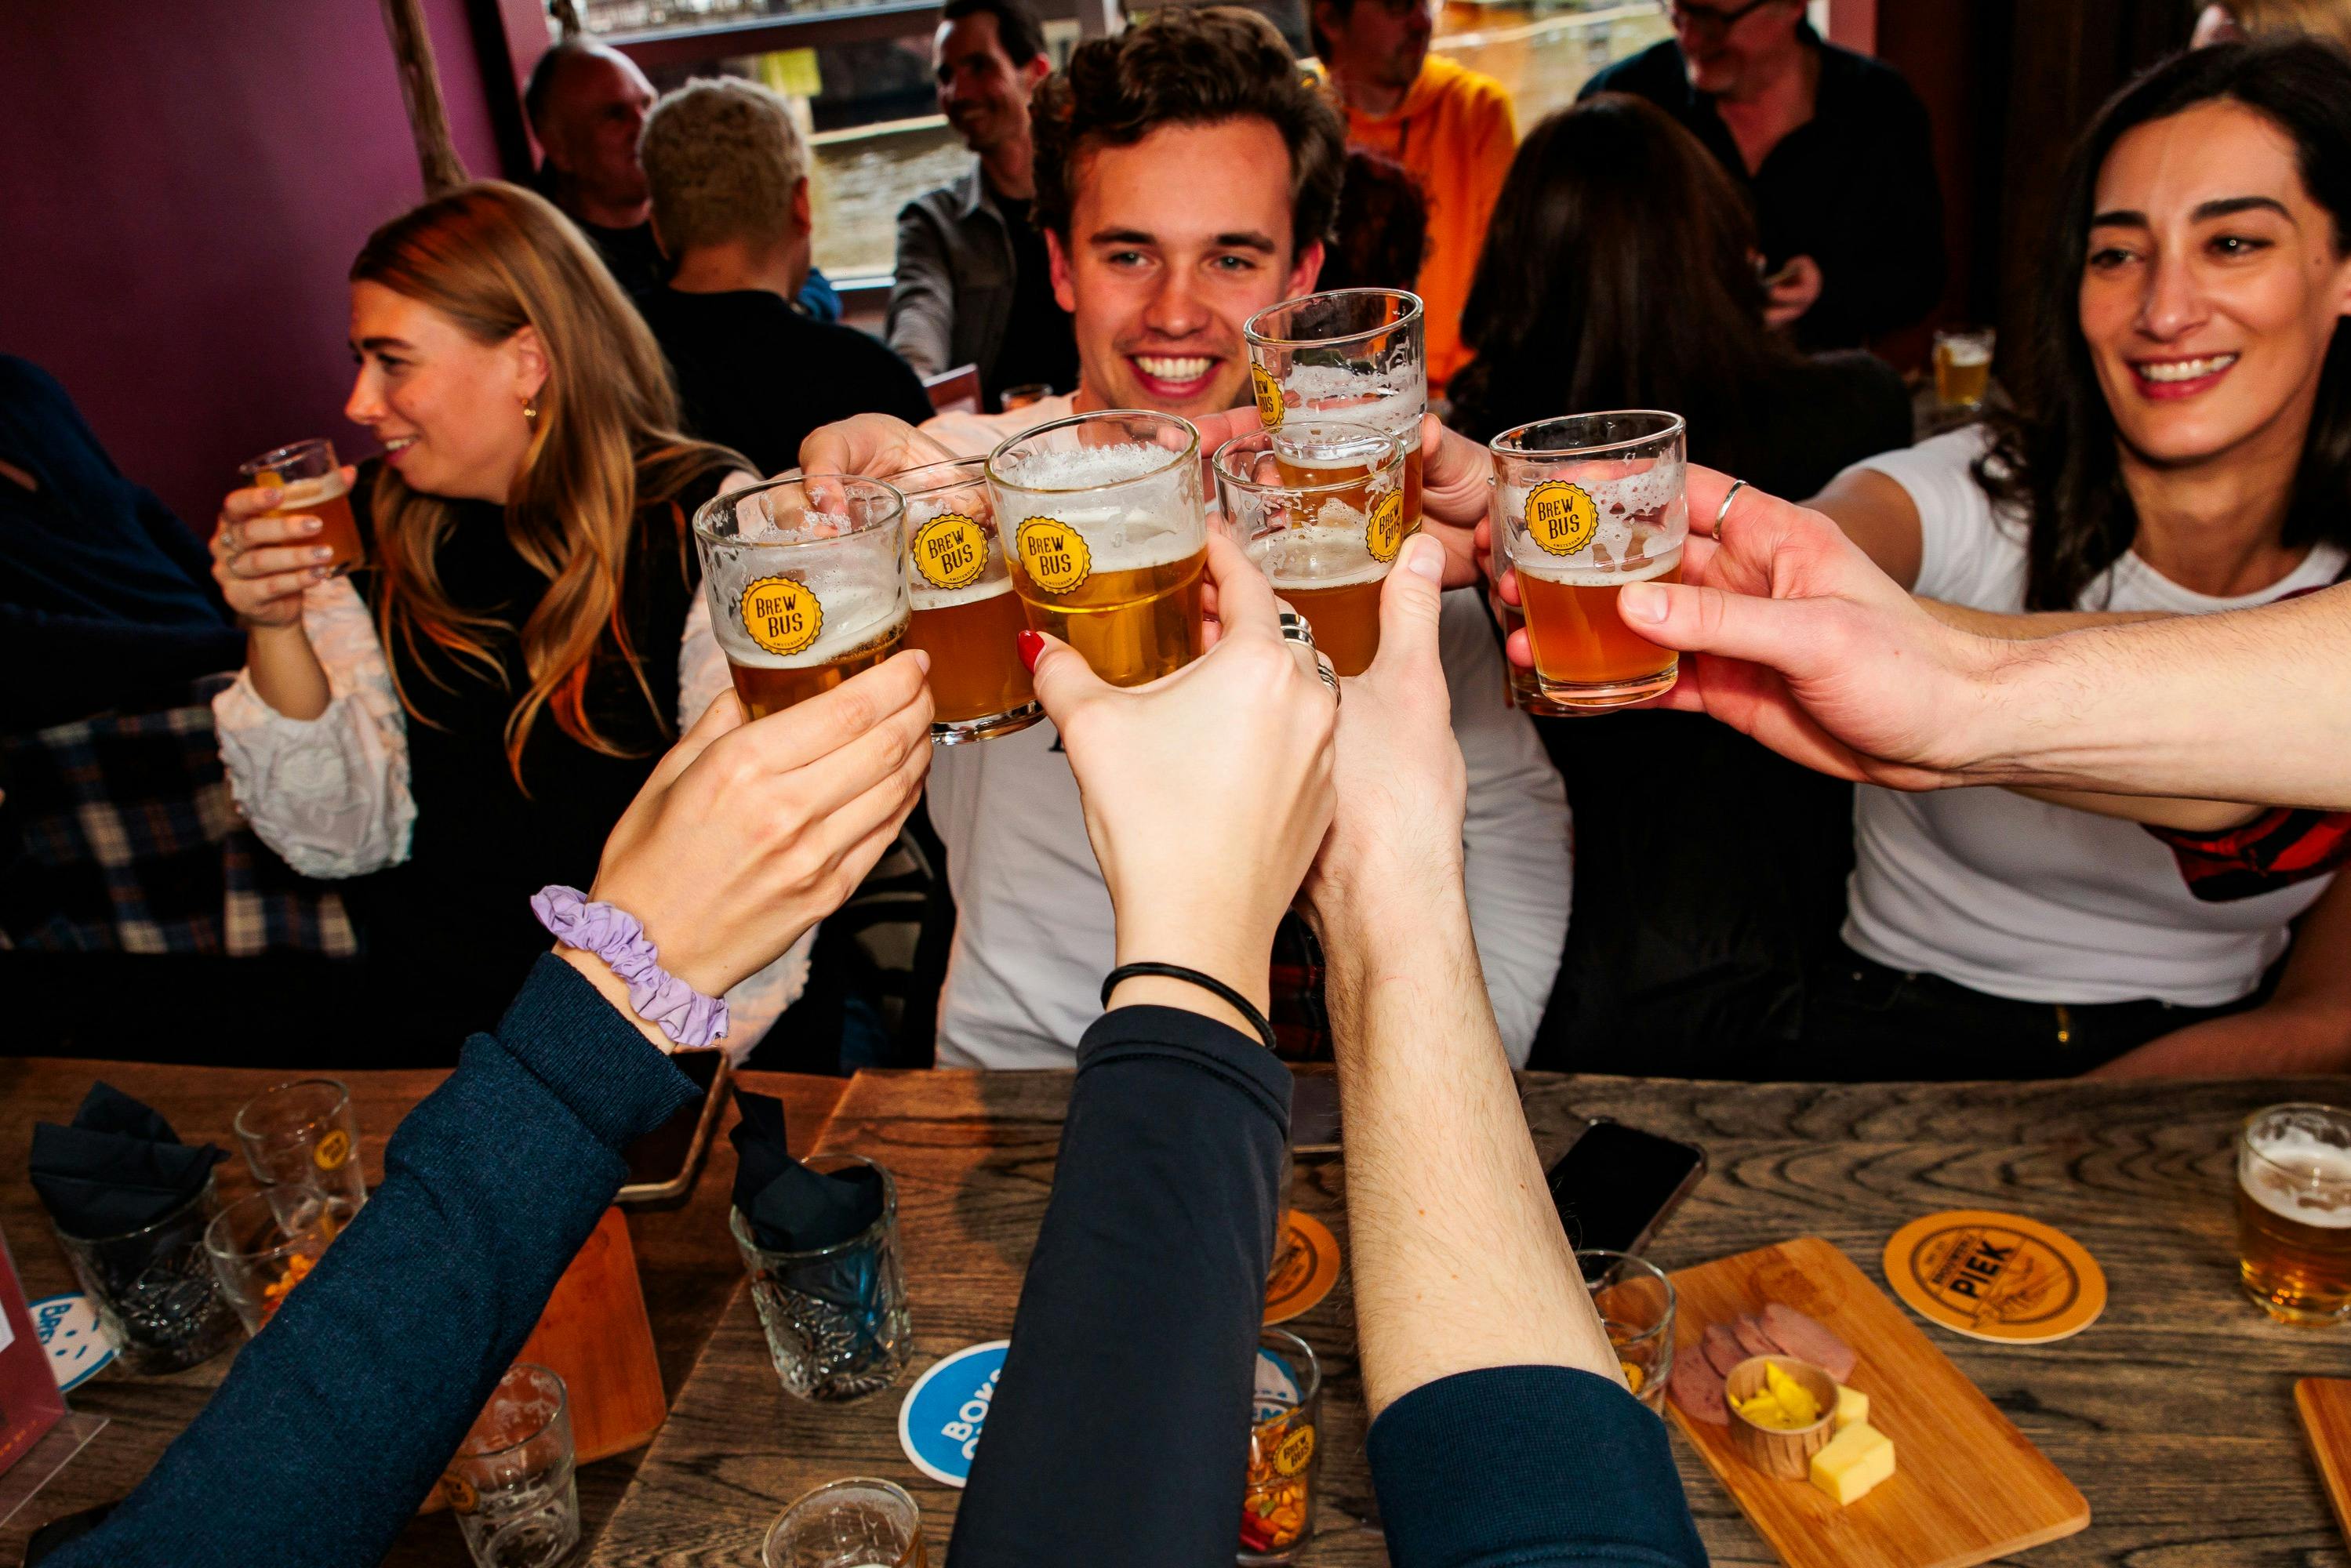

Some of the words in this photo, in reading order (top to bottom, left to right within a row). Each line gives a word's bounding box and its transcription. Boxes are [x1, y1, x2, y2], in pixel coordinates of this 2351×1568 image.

[1379, 499, 1401, 535] BREW
[1537, 495, 1574, 522] BREW
[1385, 515, 1401, 549] BUS
[1548, 514, 1580, 540] BUS
[927, 526, 965, 560] BREW
[1027, 535, 1064, 556] BREW
[941, 543, 973, 575] BUS
[1039, 554, 1072, 576] BUS
[949, 566, 976, 582] AMSTERDAM
[755, 593, 796, 619] BREW
[768, 612, 803, 638] BUS
[1949, 1240, 2014, 1300] PIEK
